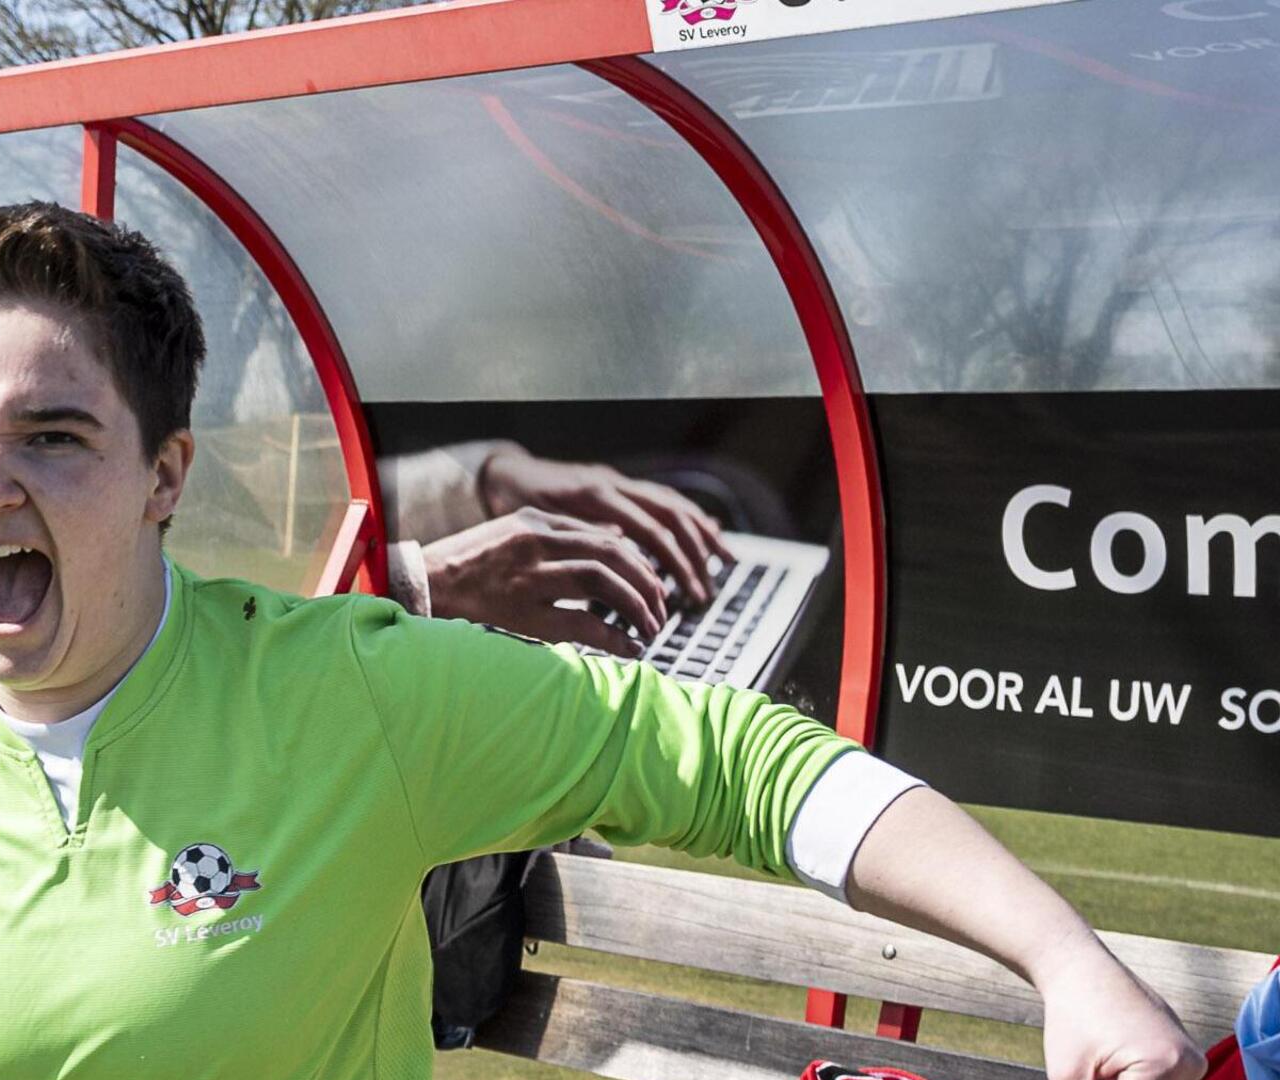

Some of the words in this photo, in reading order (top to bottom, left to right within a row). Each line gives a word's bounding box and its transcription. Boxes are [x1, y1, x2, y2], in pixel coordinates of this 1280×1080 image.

[679, 27, 694, 41] SV
[700, 24, 746, 38] Leveroy
[895, 663, 1024, 712] VOOR
[1034, 675, 1094, 718] AL
[1109, 679, 1192, 725] UW
[1218, 687, 1280, 734] SO
[154, 927, 178, 948] SV
[185, 913, 264, 945] Leveroy
